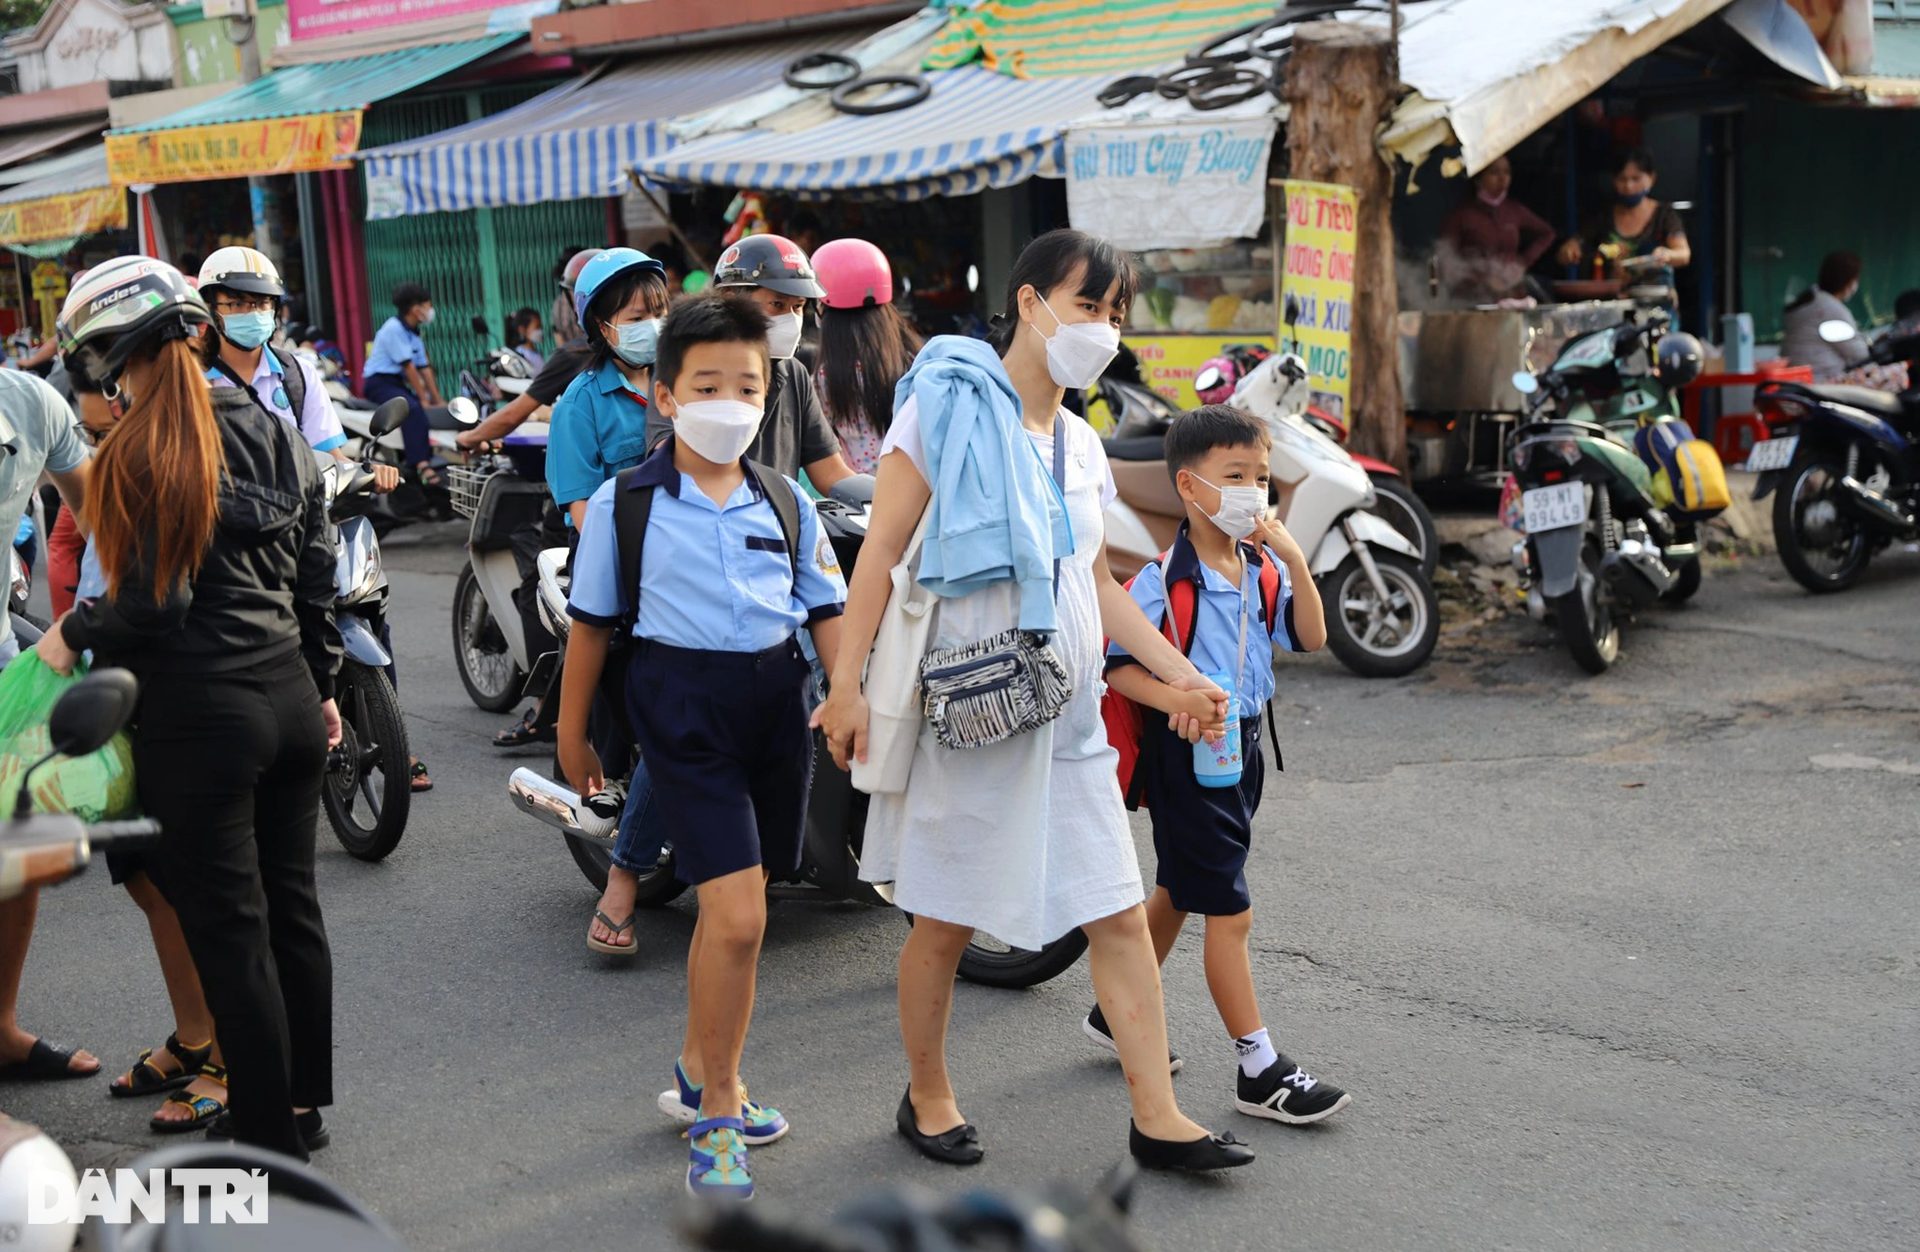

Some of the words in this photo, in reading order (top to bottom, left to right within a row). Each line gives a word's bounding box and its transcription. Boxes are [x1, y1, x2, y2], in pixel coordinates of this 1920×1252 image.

[89, 284, 140, 315] Andes
[1152, 366, 1193, 381] CANH
[1308, 344, 1348, 385] MỌC
